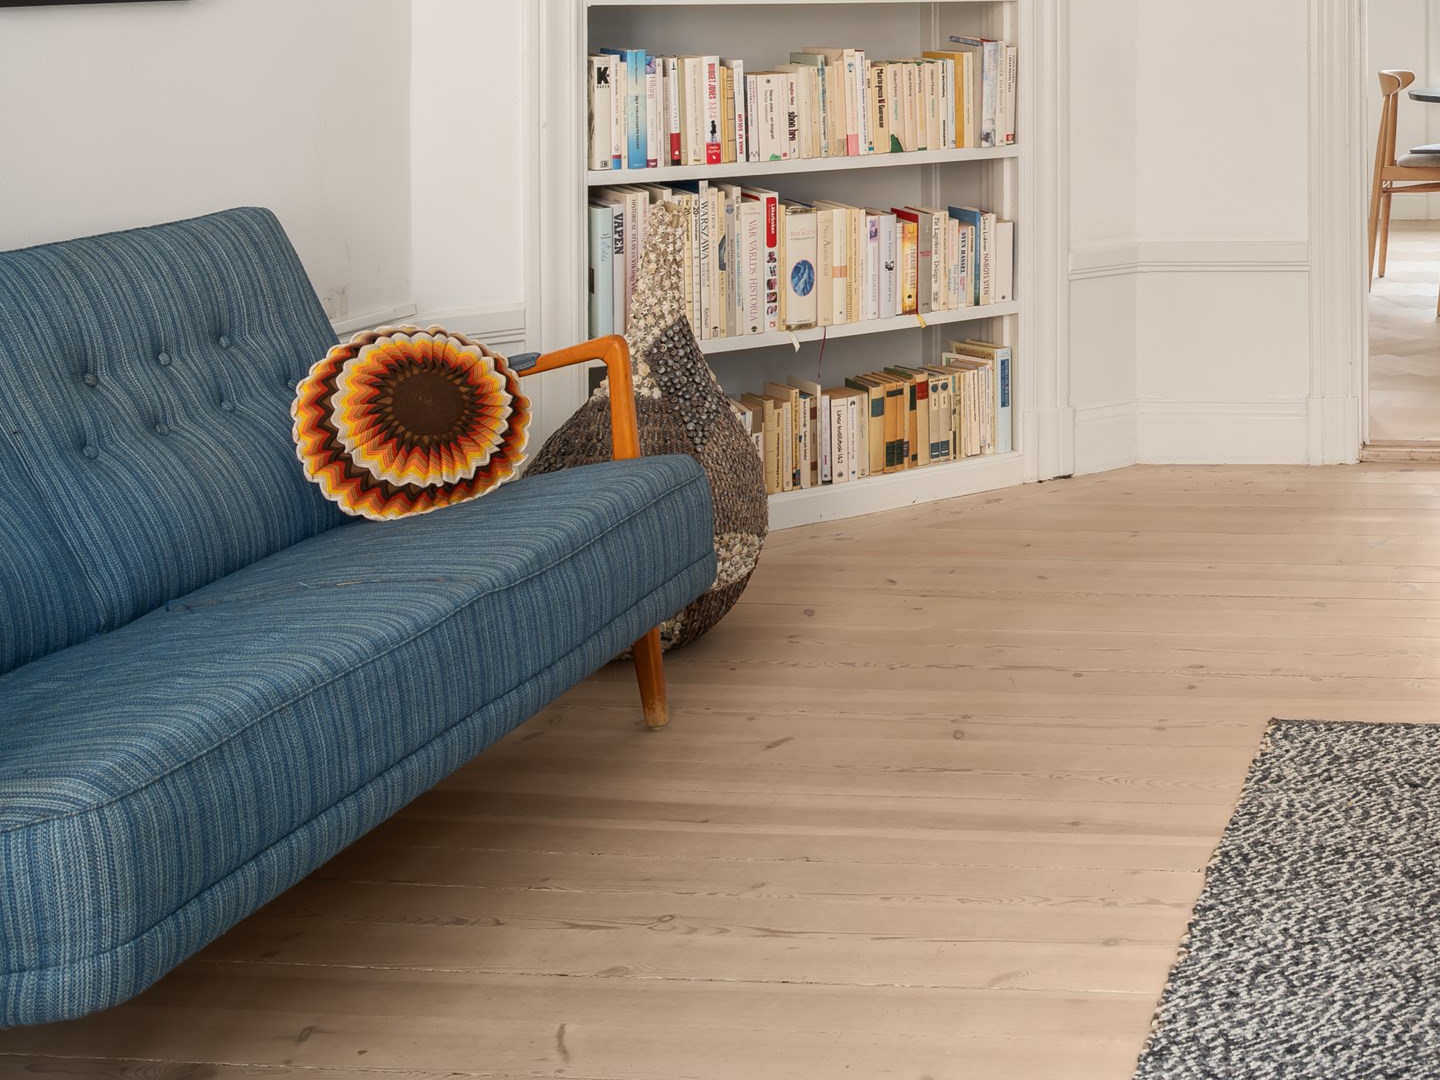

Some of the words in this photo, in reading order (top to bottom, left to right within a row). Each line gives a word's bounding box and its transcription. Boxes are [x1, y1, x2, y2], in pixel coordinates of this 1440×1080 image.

[708, 63, 716, 82] BRIDGET
[876, 68, 884, 84] Mario
[788, 112, 797, 128] shoo
[789, 129, 798, 141] bre
[614, 213, 624, 254] VAPEN
[701, 200, 709, 260] WARSZAWA
[748, 220, 756, 236] VÅR
[749, 240, 757, 274] VÄRLDS
